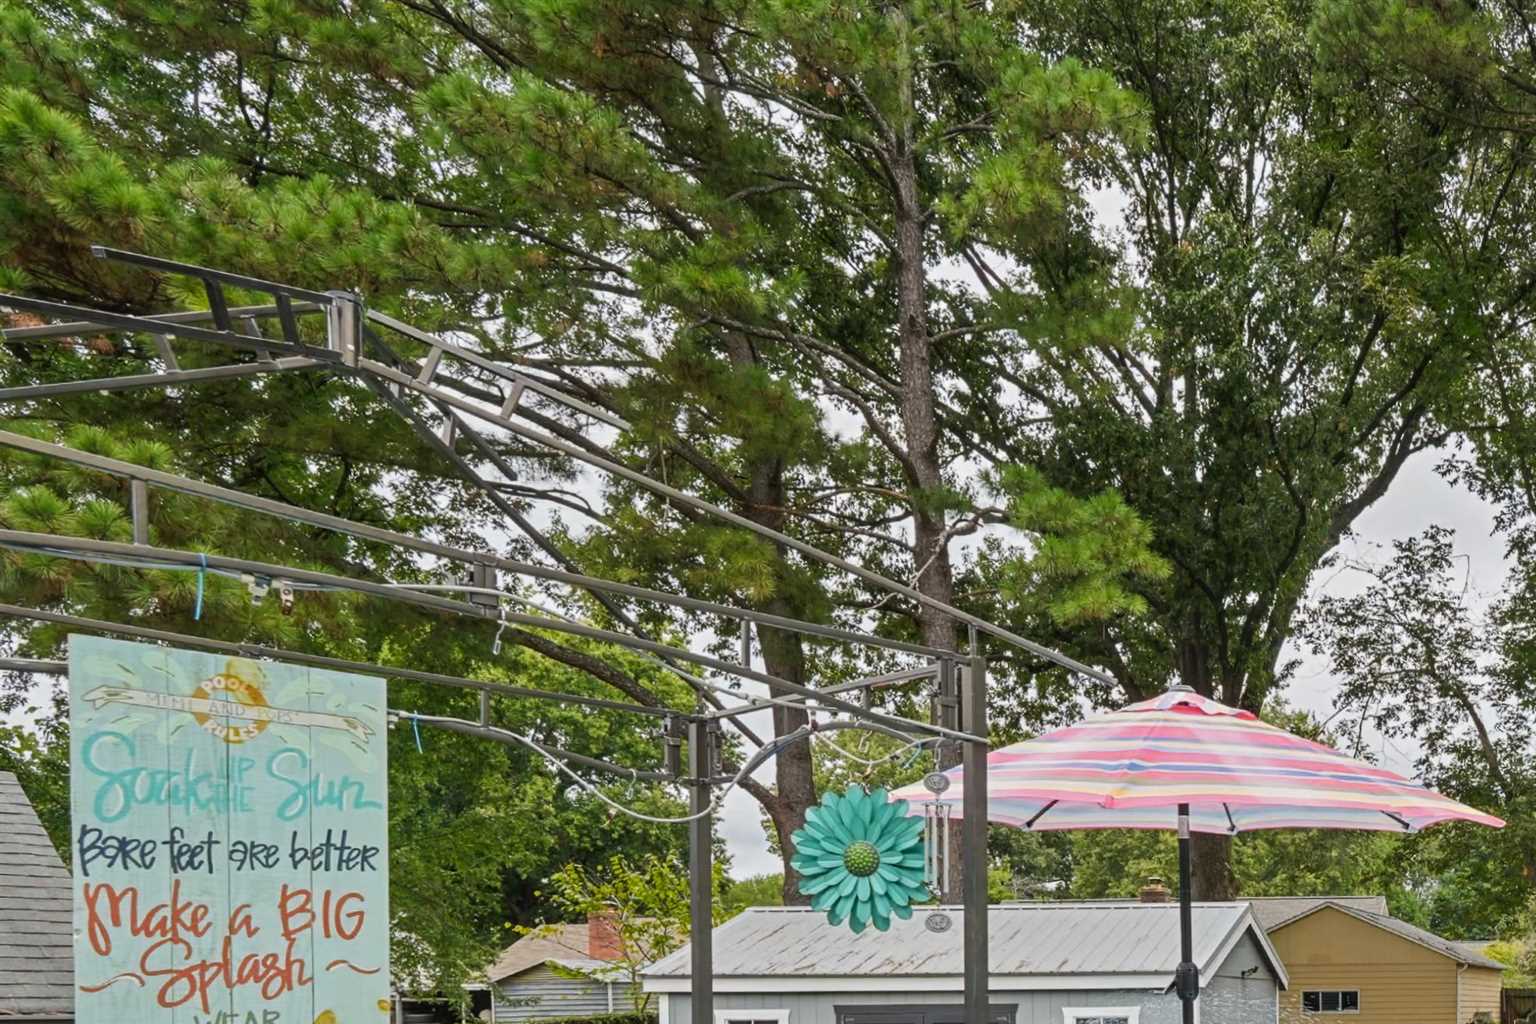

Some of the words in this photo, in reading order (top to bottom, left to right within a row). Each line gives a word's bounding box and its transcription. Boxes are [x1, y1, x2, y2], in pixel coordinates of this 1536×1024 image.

[201, 675, 251, 693] POOL
[208, 701, 246, 716] AND
[202, 719, 258, 742] RULES
[81, 730, 212, 823] Soak
[220, 756, 256, 781] UP
[266, 746, 383, 822] Sun
[211, 784, 257, 816] THE
[162, 826, 221, 875] feet
[83, 878, 213, 957] Make
[229, 903, 261, 938] a
[278, 883, 366, 941] BIG
[140, 935, 313, 1015] Splash
